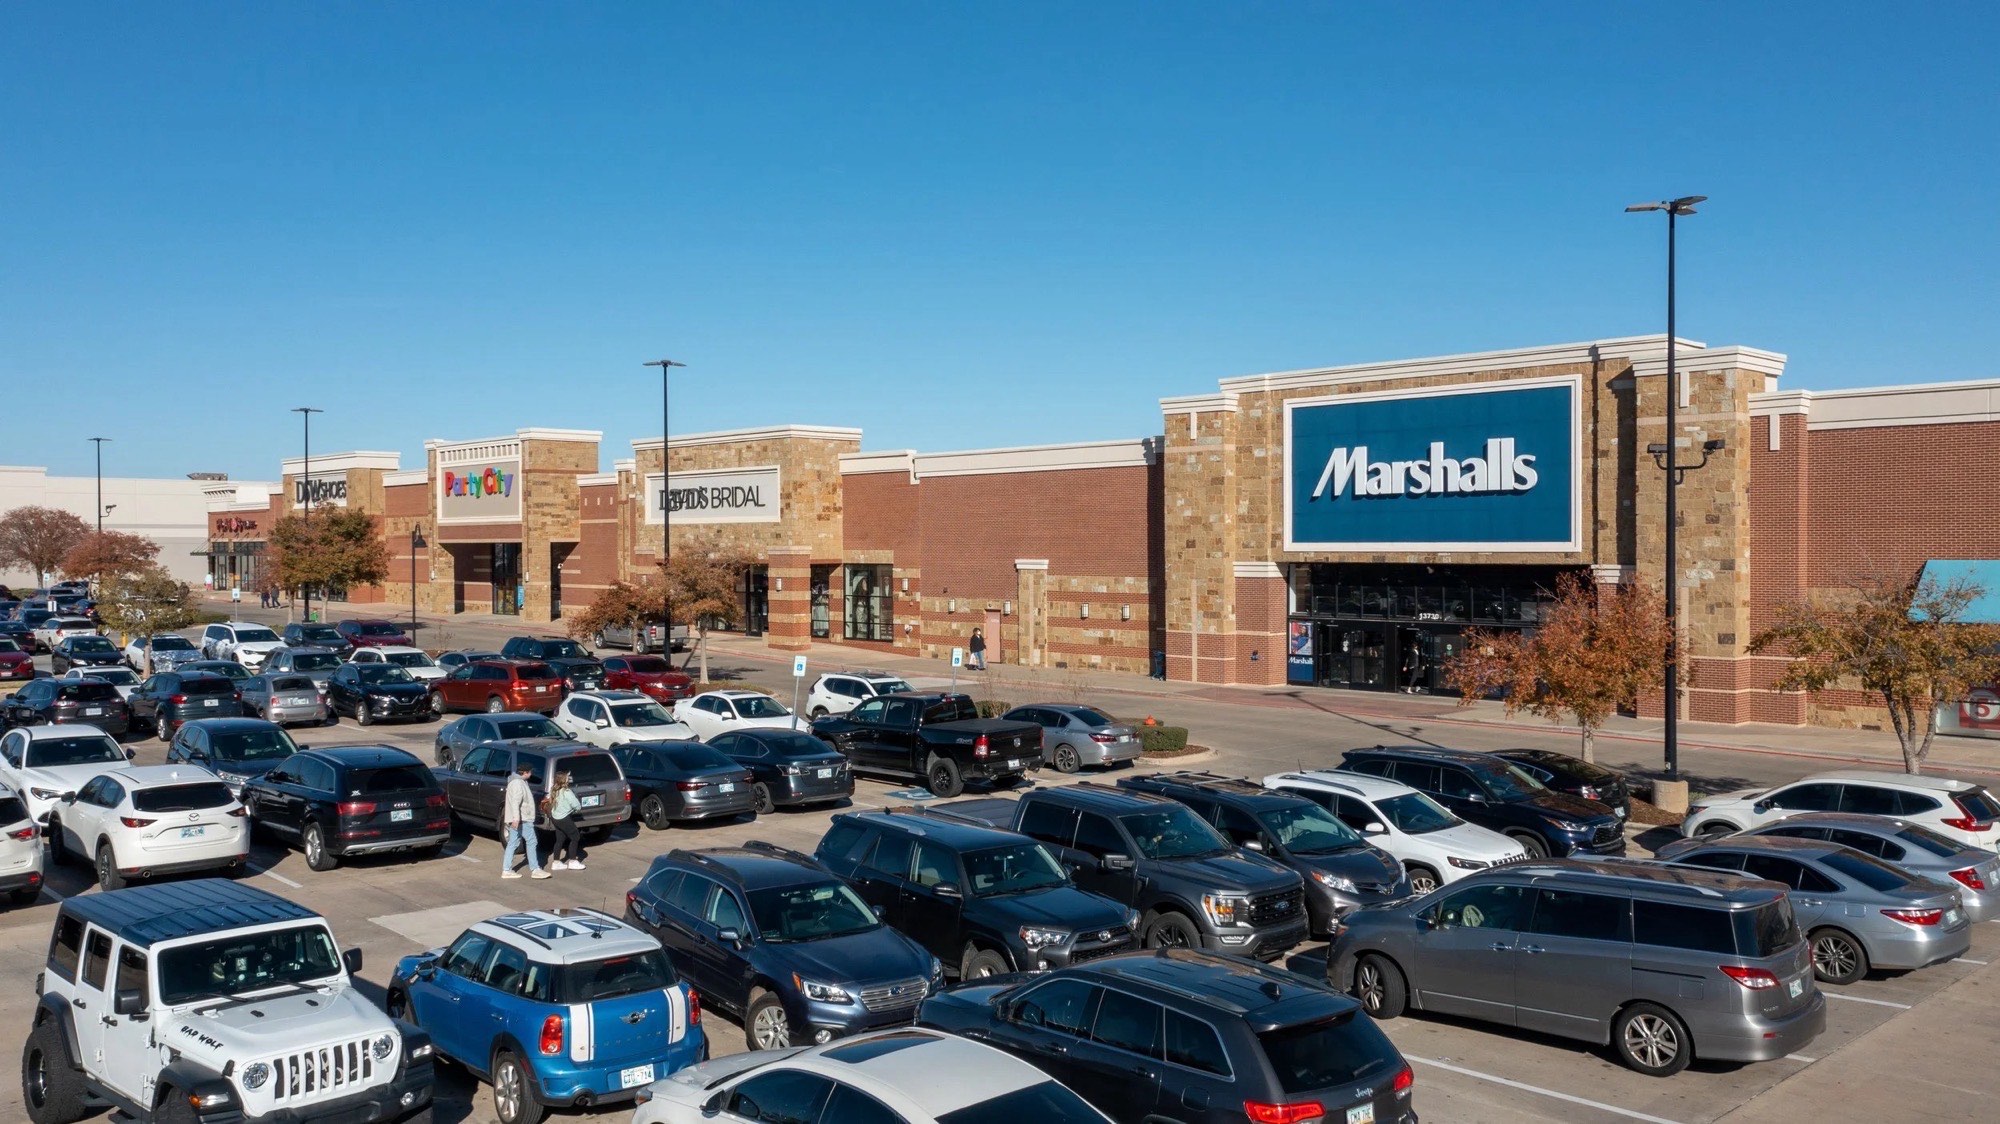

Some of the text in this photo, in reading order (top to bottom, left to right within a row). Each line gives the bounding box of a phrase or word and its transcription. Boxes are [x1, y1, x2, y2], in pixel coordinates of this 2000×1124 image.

[1312, 437, 1538, 497] Marshalls
[445, 466, 514, 499] Party City
[711, 485, 766, 509] BRIDAL
[181, 1025, 224, 1050] BAD WOLF
[1355, 1087, 1374, 1098] Jeep
